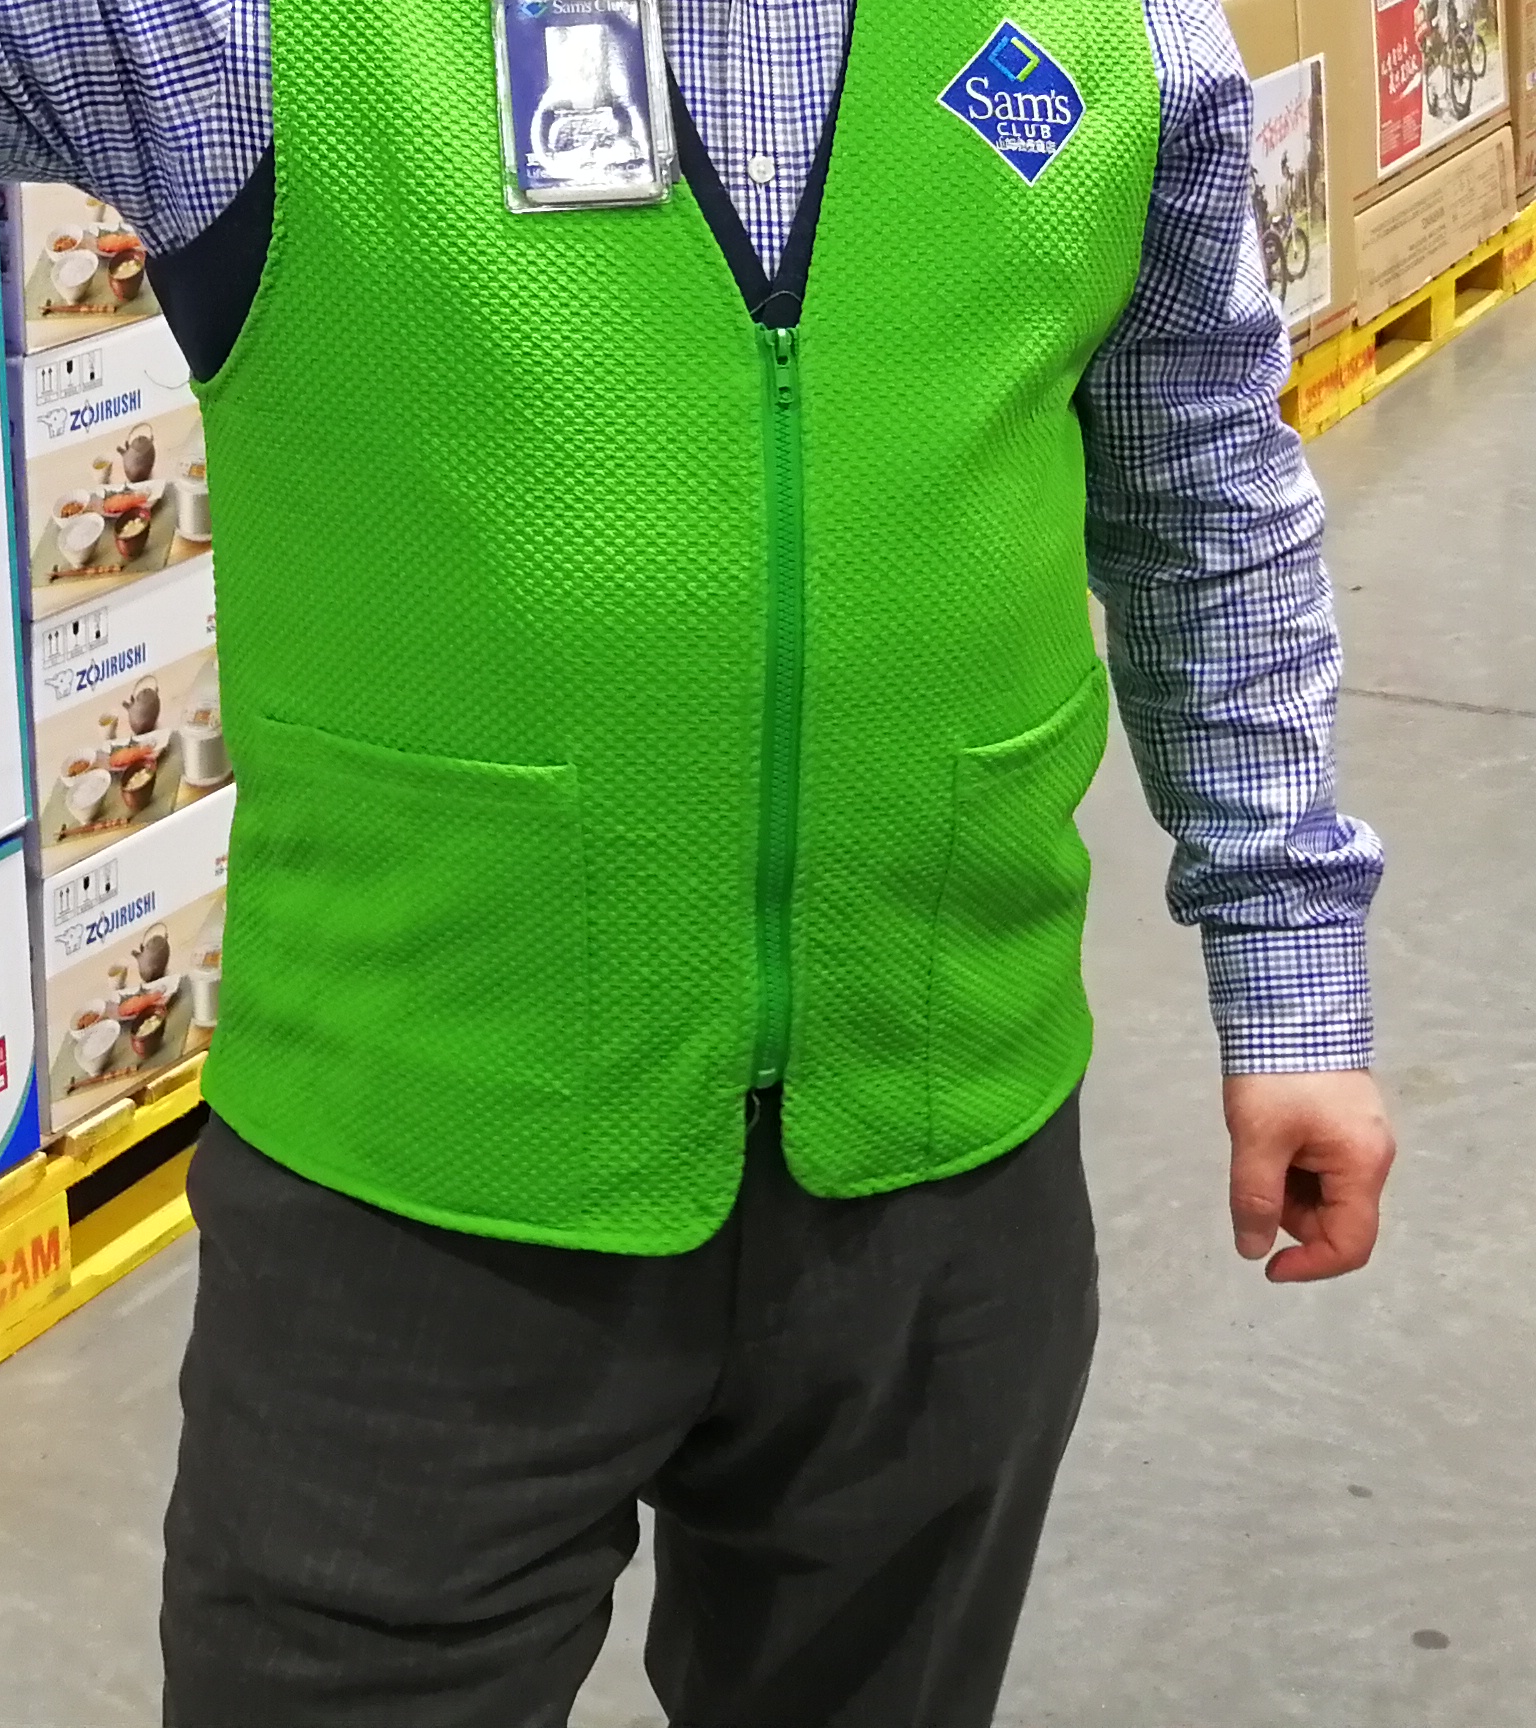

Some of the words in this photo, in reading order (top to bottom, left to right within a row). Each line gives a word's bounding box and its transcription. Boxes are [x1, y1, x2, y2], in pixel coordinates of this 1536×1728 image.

[965, 76, 1072, 125] Sam's
[996, 122, 1052, 139] CLUB
[69, 387, 142, 432] ZOJIRUSHI
[75, 641, 147, 692] ZOJIRUSHI
[85, 889, 157, 945] ZOJIRUSHI
